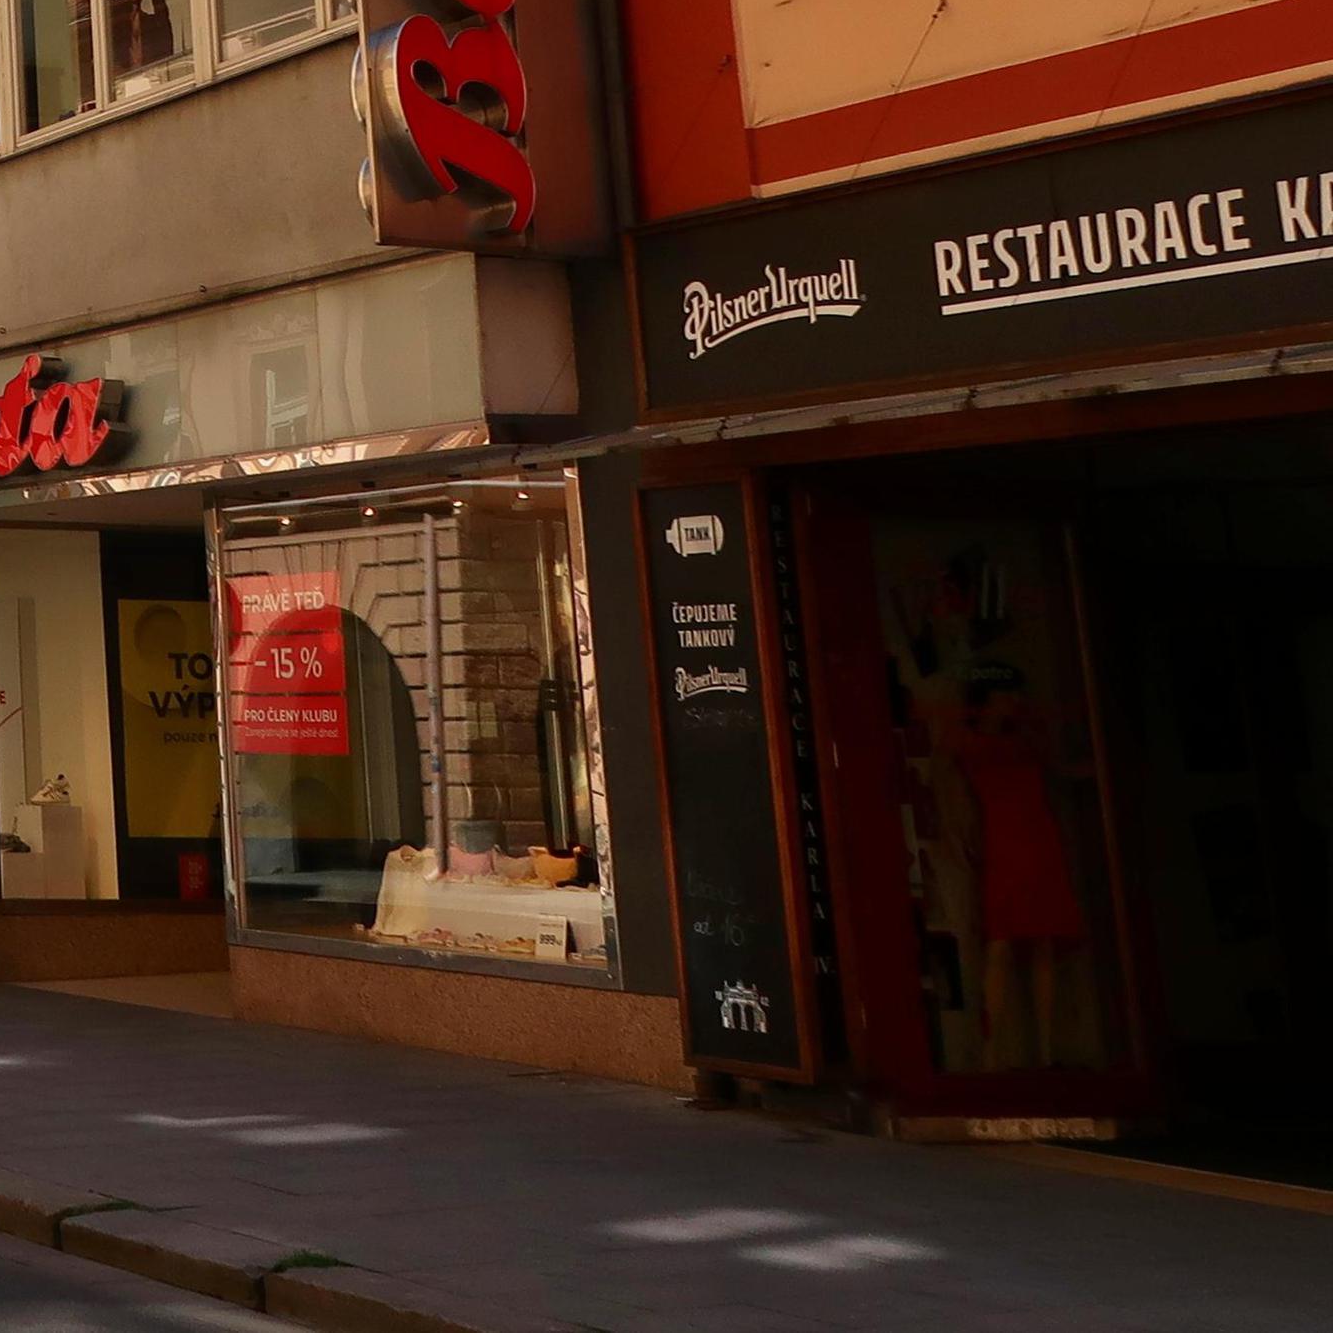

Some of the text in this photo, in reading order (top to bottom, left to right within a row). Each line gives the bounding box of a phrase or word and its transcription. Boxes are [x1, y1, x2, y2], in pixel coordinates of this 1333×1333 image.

[934, 188, 1252, 297] RESTAURACE
[683, 259, 859, 360] Pilsner Urquell
[684, 528, 711, 542] TANK
[243, 586, 325, 613] PRÁVĚ TEĎ
[672, 602, 738, 624] ČEPUJEME
[678, 624, 734, 648] TANKOVÝ
[244, 706, 337, 722] PRO ČLENY KLUBU
[770, 504, 807, 758] RESTAURACE
[800, 792, 826, 920] KARLA
[164, 731, 204, 745] pouze
